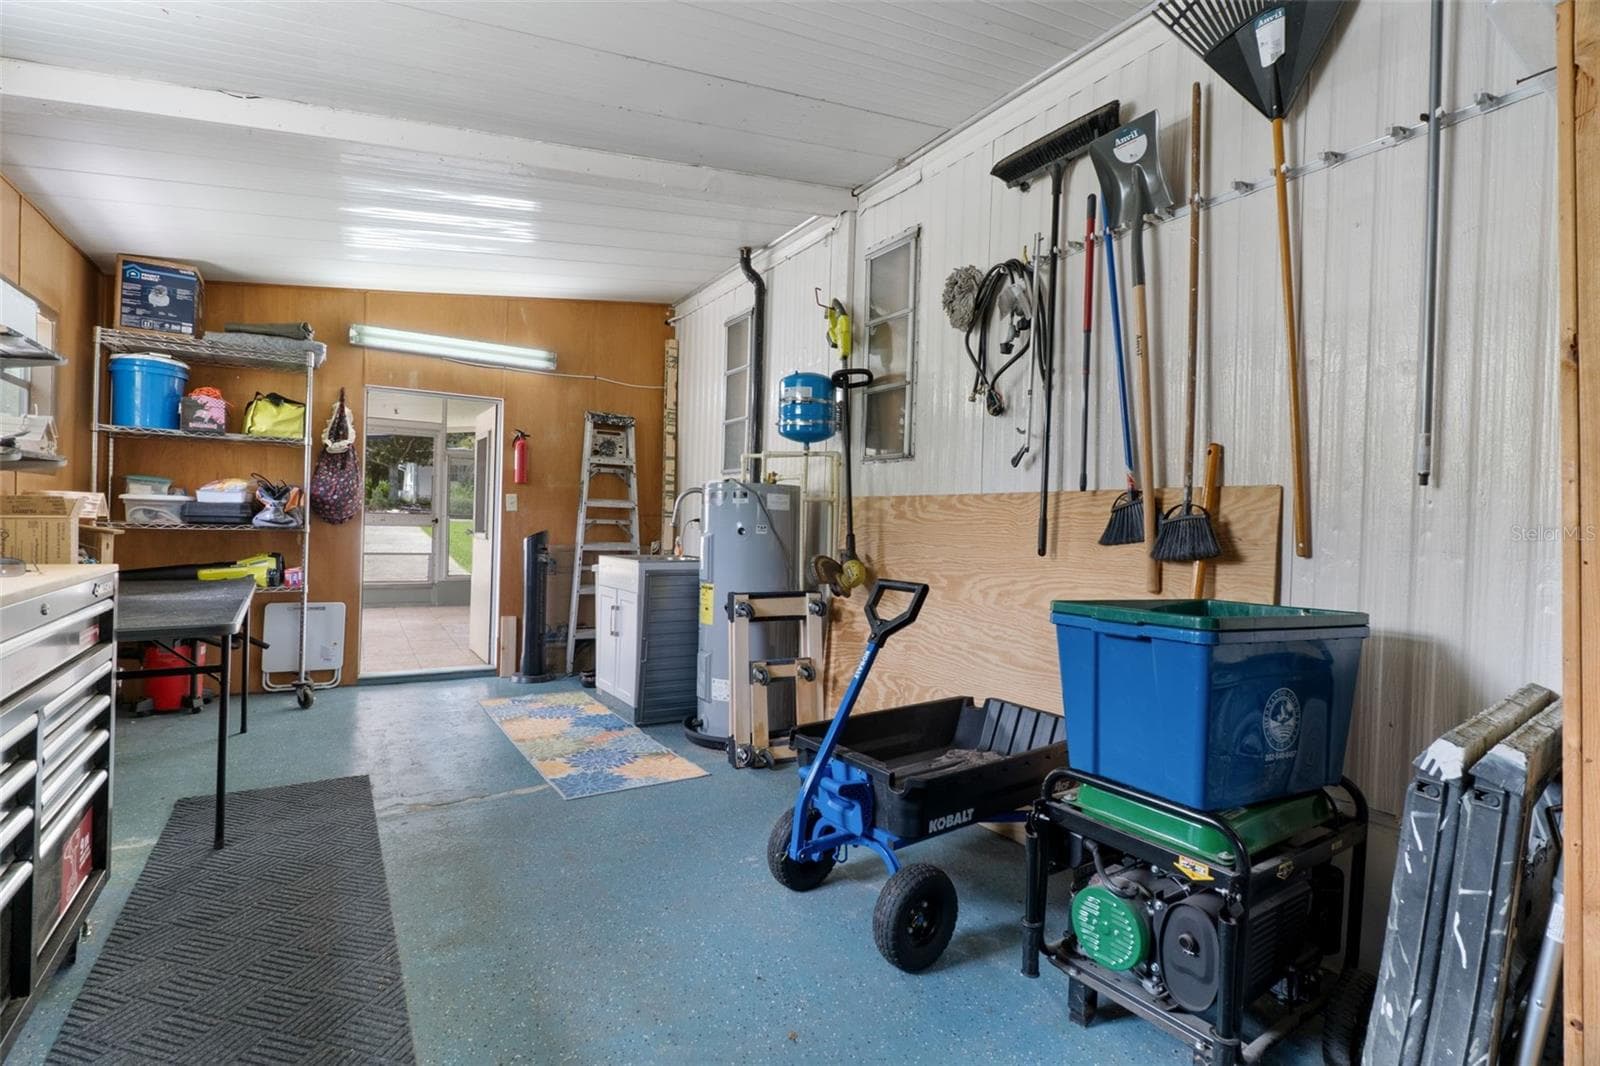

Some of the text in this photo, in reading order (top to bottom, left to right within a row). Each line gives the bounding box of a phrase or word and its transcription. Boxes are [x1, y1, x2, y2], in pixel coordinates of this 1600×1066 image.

[1257, 10, 1283, 27] Anvil
[1115, 129, 1139, 146] Anvil
[928, 808, 975, 833] KOBALT
